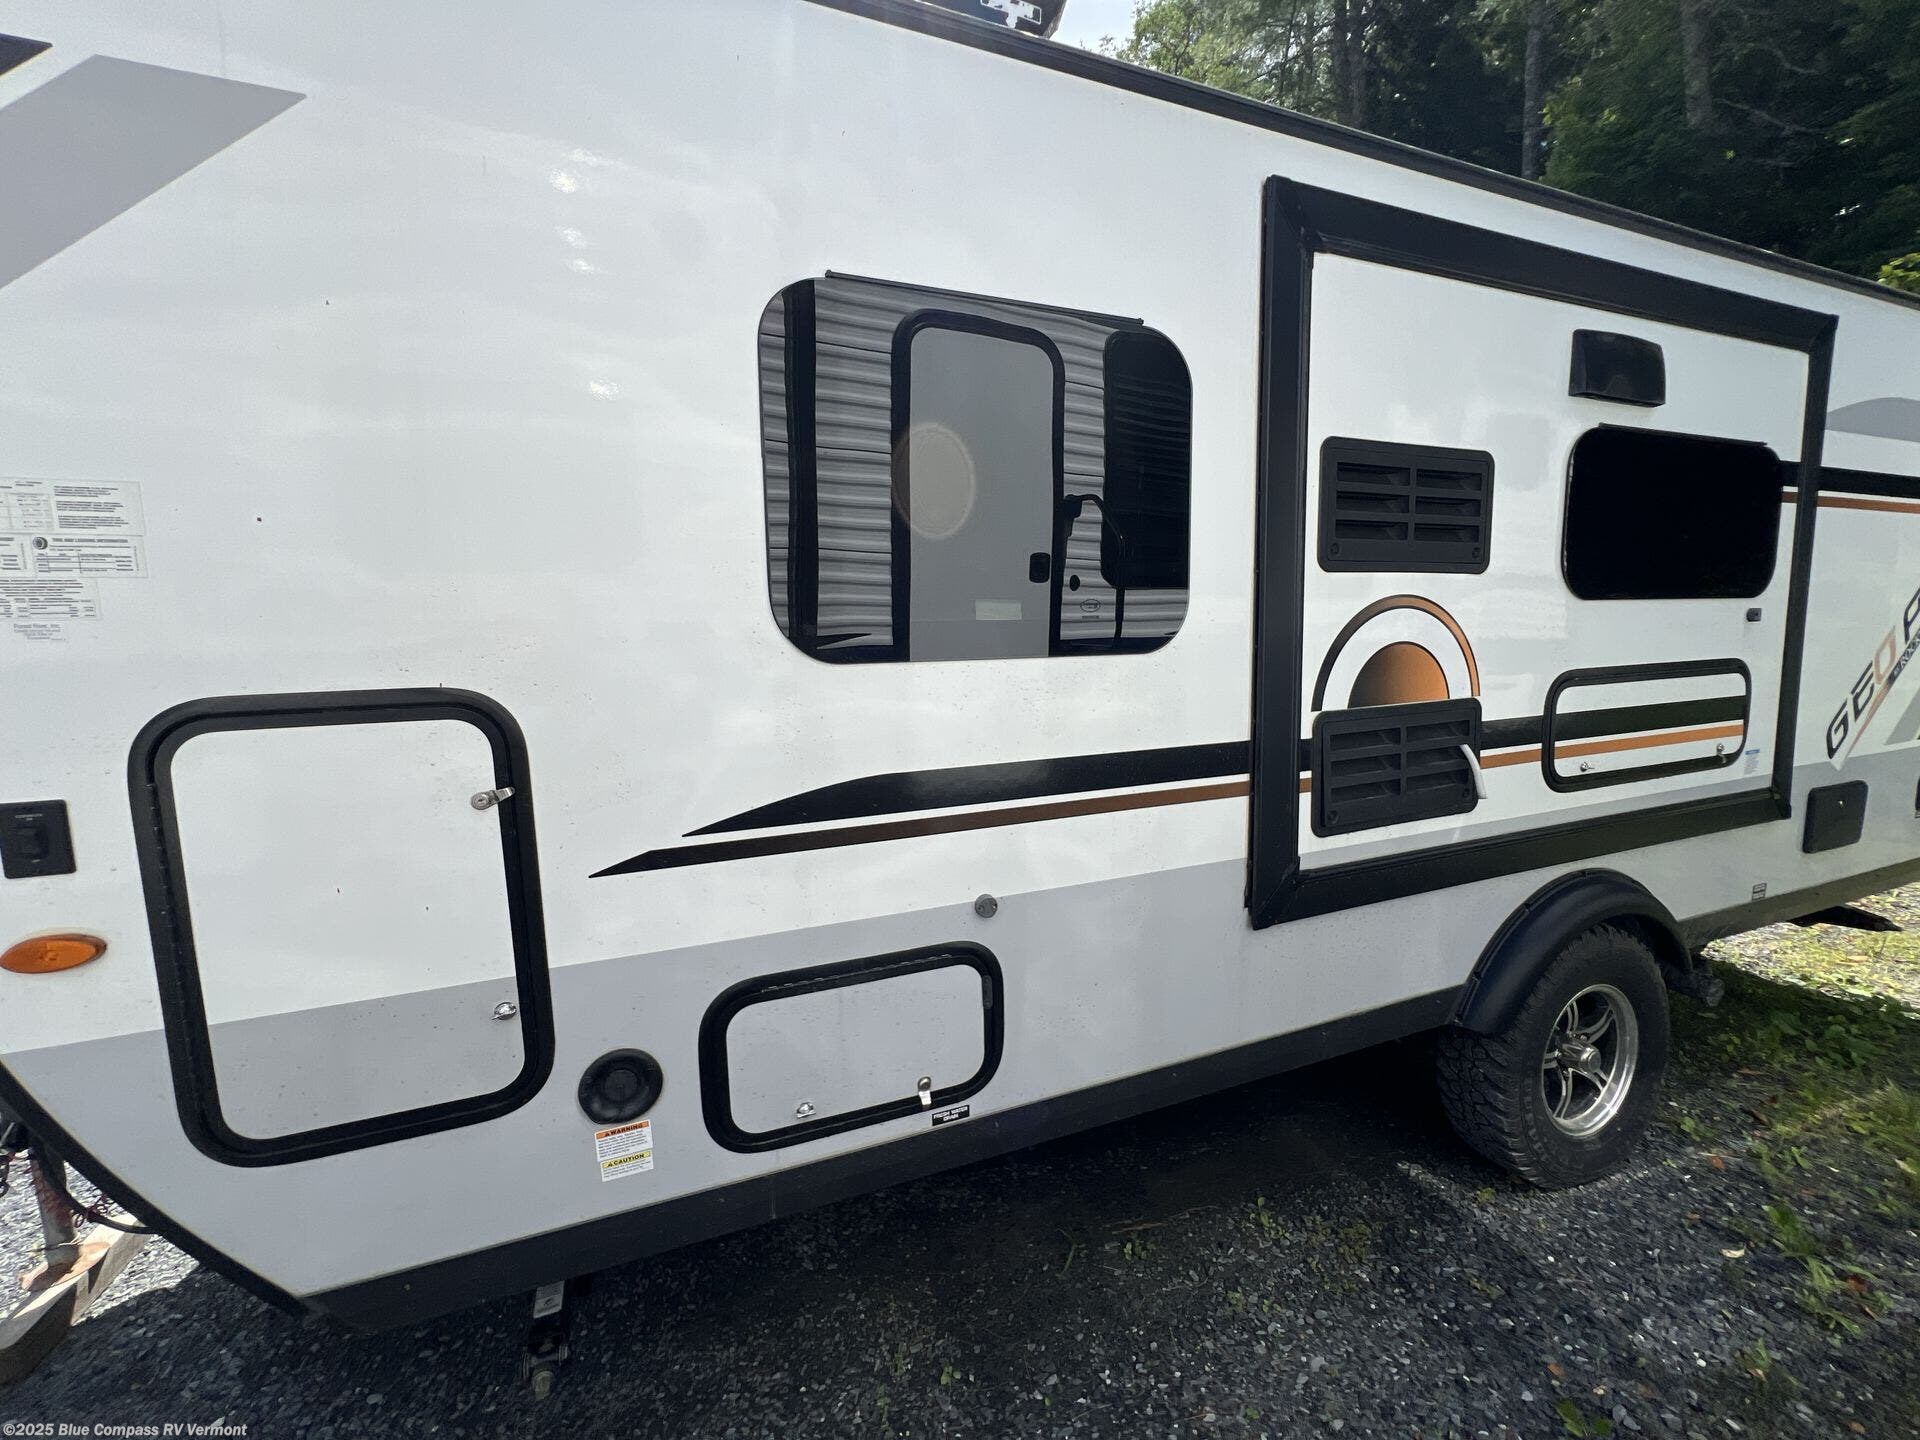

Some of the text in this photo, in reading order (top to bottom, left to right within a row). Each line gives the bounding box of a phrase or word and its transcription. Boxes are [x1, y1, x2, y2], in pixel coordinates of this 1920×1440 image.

[1826, 624, 1896, 759] GEO
[610, 1122, 643, 1135] WARNING
[613, 1153, 645, 1165] CAUTION
